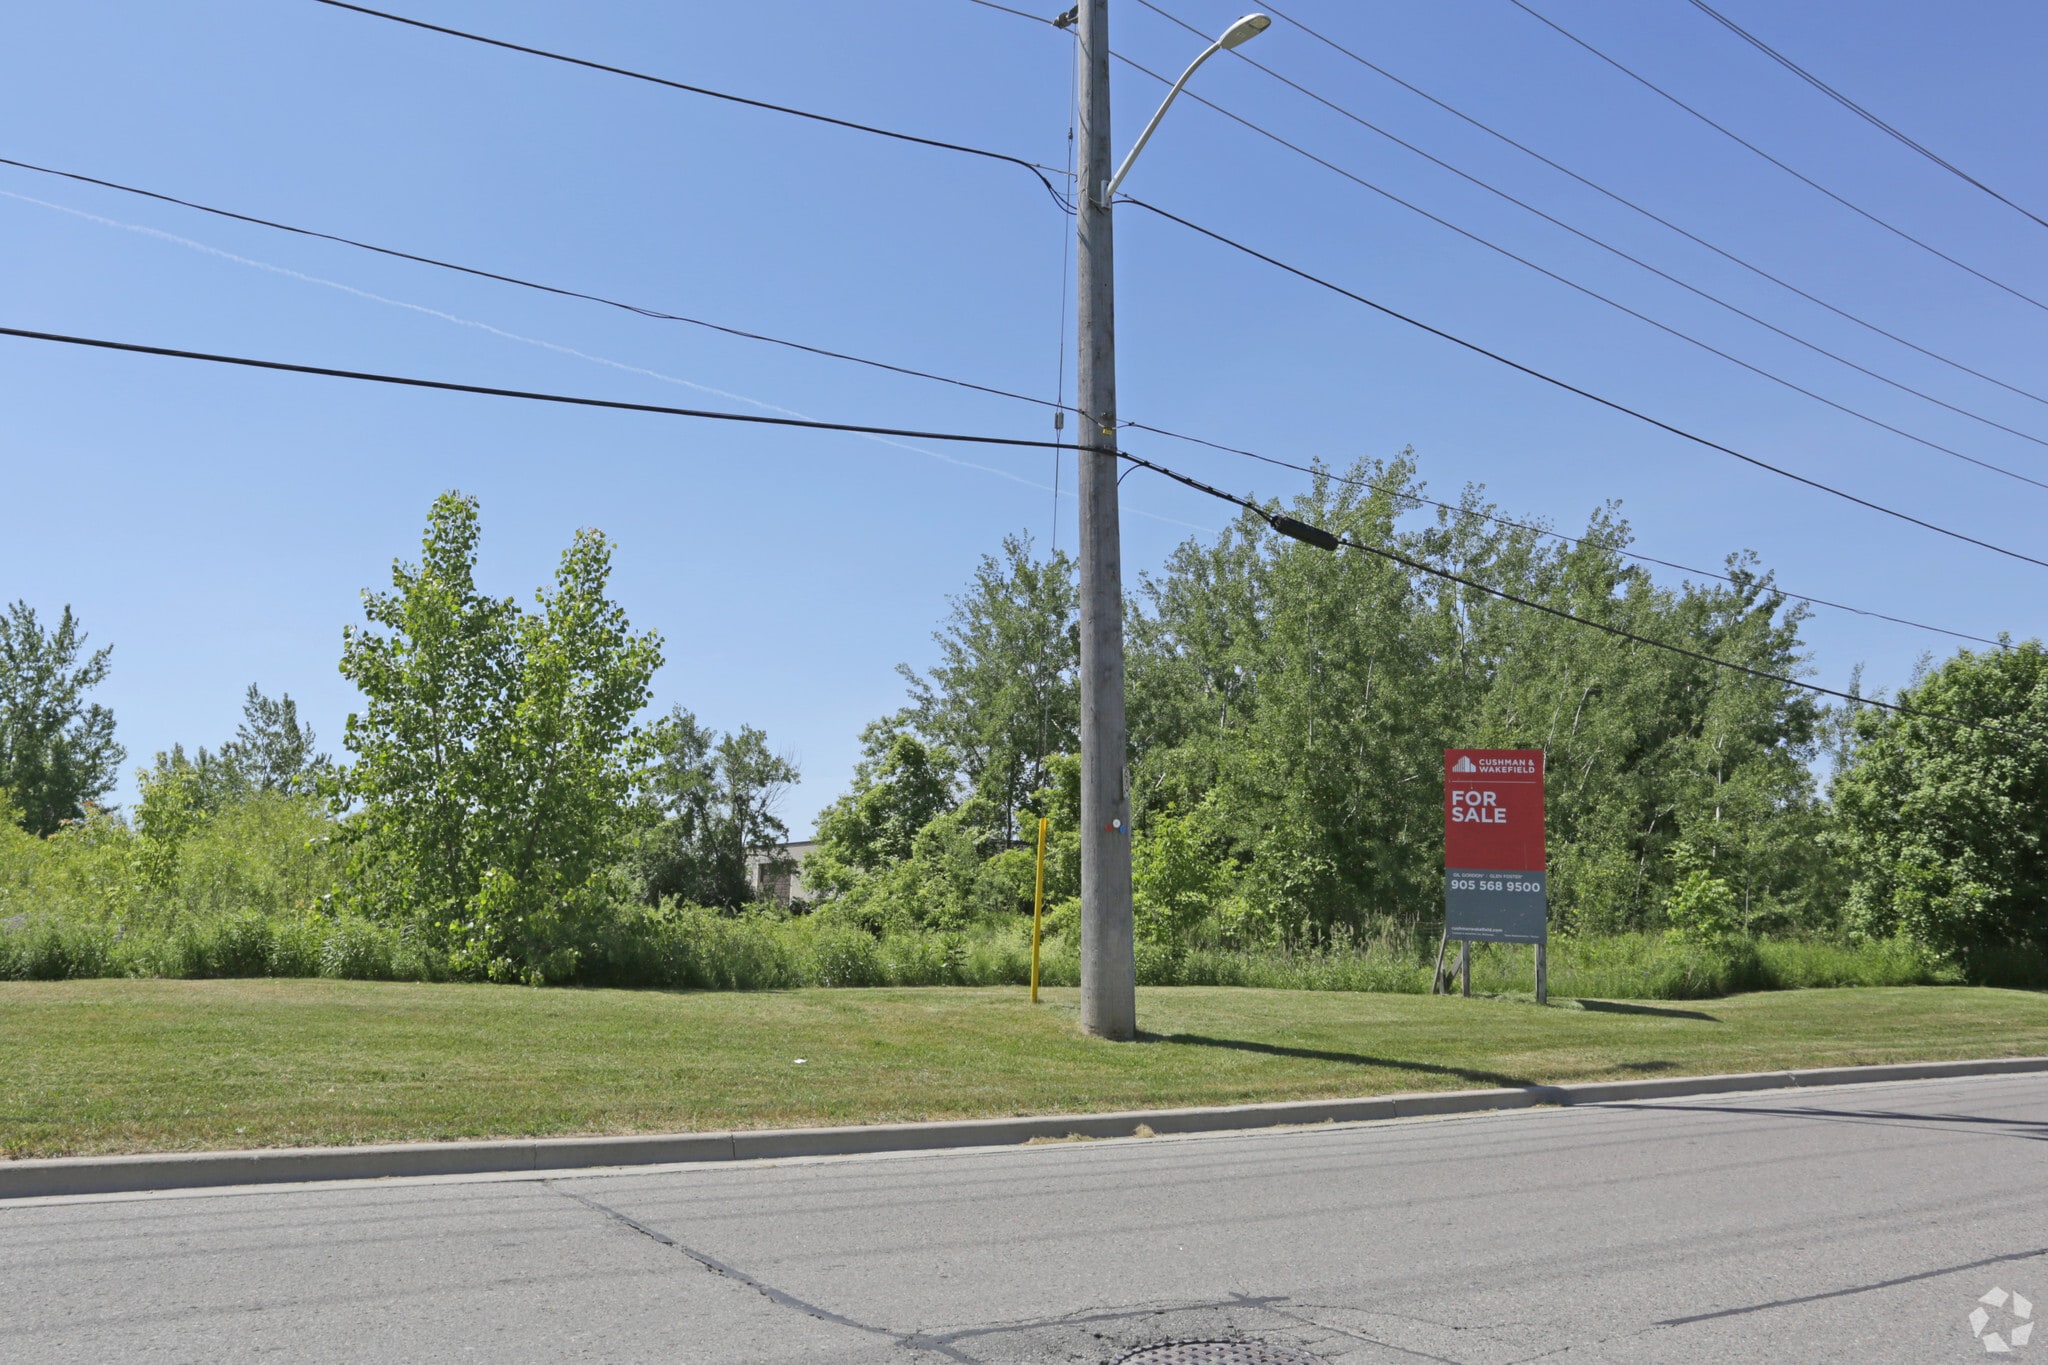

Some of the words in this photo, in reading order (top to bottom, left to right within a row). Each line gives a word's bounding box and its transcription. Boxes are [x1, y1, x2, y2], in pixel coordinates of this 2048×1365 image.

[1452, 790, 1497, 806] FOR
[1452, 807, 1507, 823] SALE
[1451, 880, 1475, 890] 905
[1480, 881, 1503, 891] 568
[1507, 882, 1540, 892] 9500
